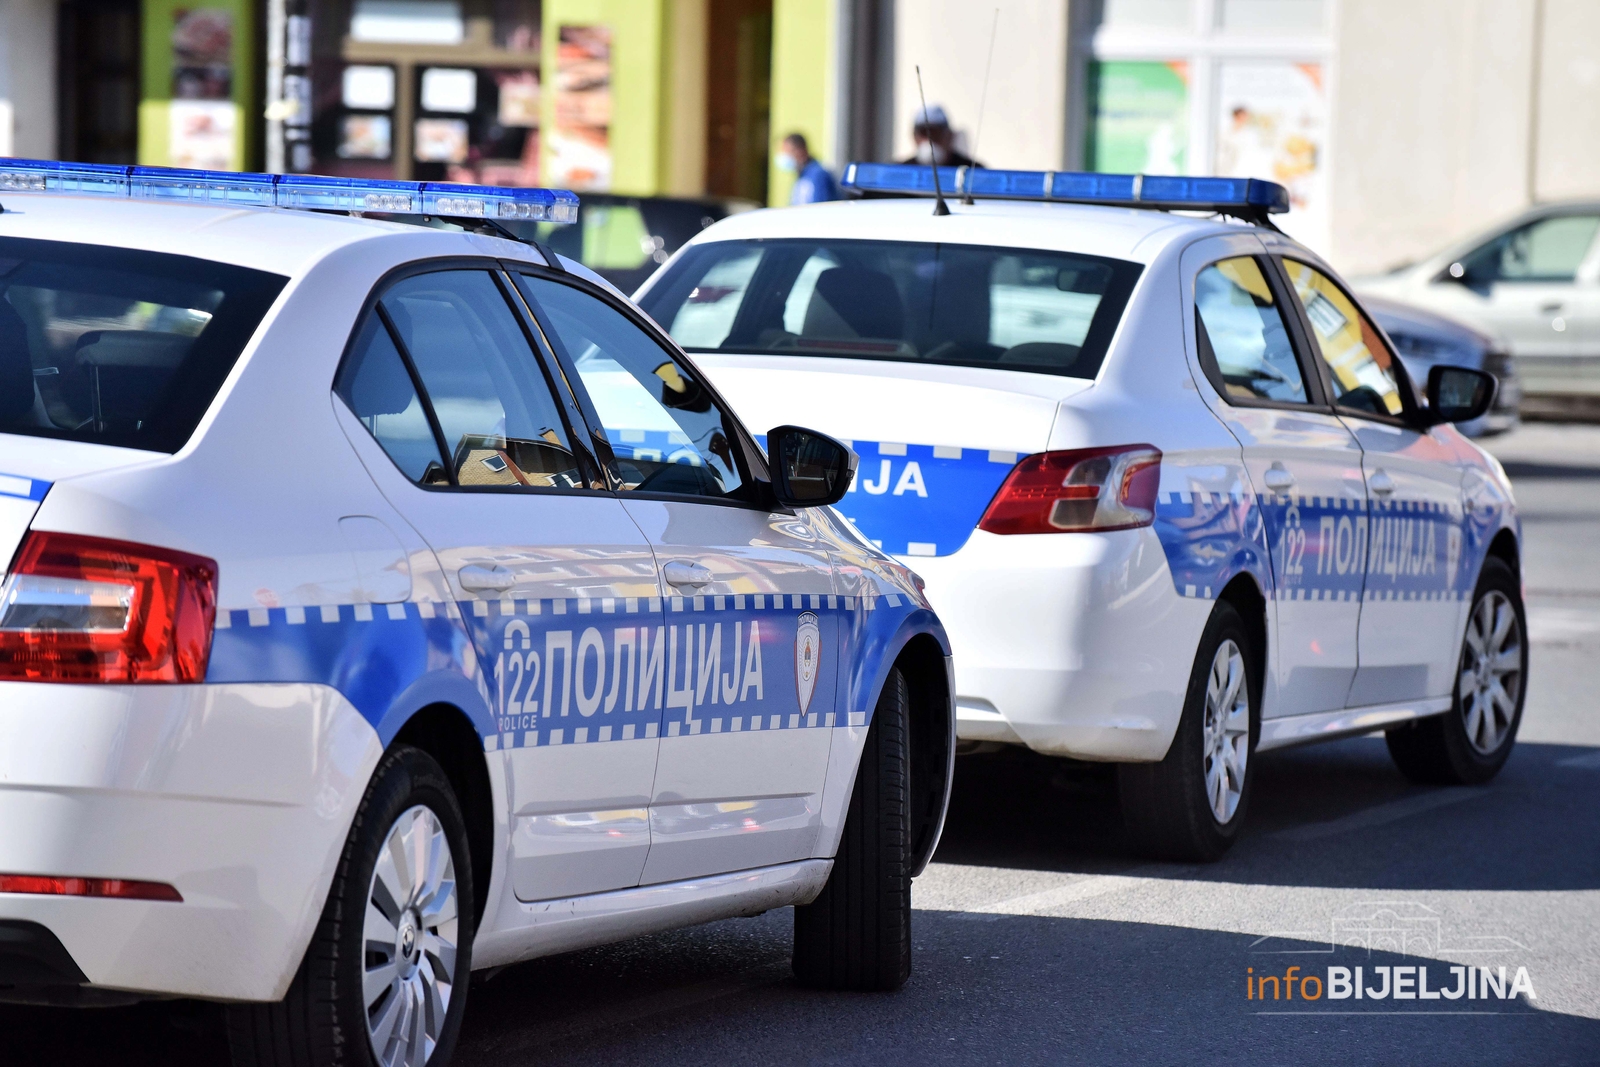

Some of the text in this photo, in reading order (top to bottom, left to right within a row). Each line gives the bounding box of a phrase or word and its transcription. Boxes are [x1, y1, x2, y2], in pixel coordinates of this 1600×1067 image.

[1279, 528, 1306, 575] 122
[1317, 515, 1436, 583] ПОЛИЦИЈА
[494, 651, 540, 716] 122
[542, 620, 764, 725] ПОЛИЦИЈА
[498, 714, 537, 732] POLICE
